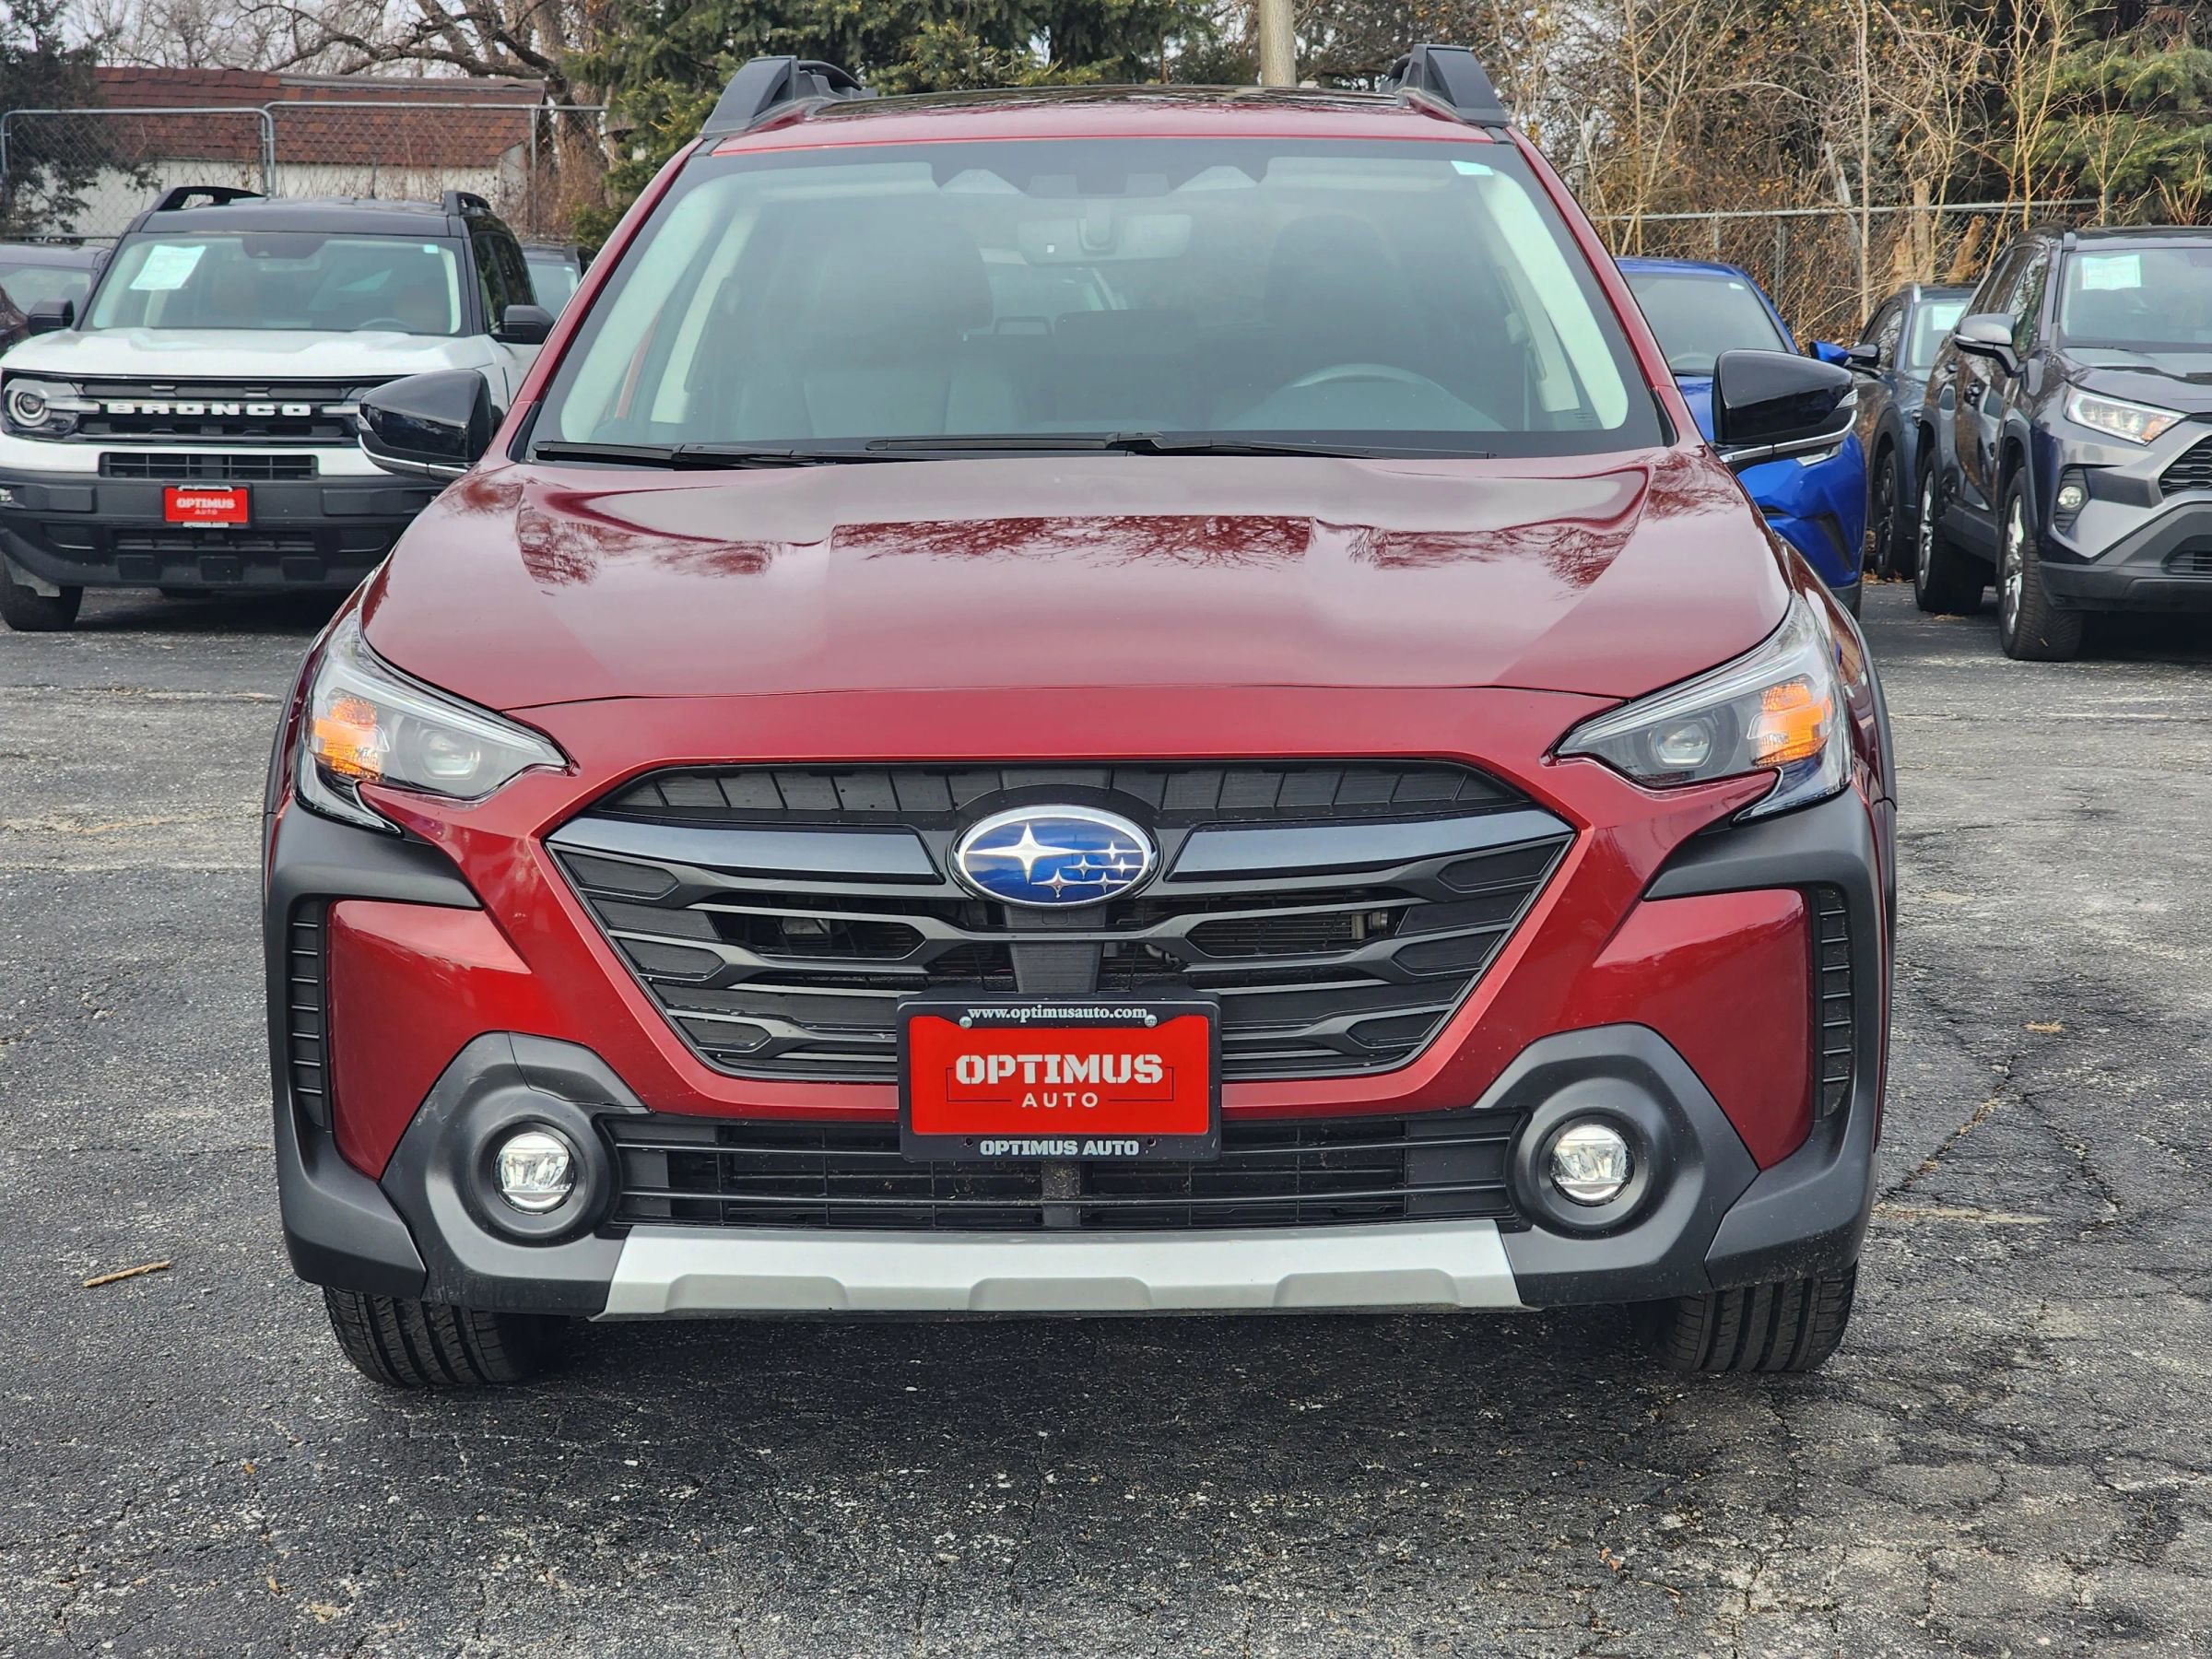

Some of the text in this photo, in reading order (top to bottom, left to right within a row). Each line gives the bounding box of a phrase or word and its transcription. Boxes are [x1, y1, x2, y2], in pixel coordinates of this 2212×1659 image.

[107, 402, 312, 417] BRONCO
[176, 498, 236, 509] OPTIMUS
[968, 1005, 1147, 1023] www.optimusauto.com
[955, 1053, 1163, 1085] OPTIMUS
[1021, 1092, 1099, 1108] AUTO
[980, 1139, 1139, 1155] OPTIMUS AUTO
